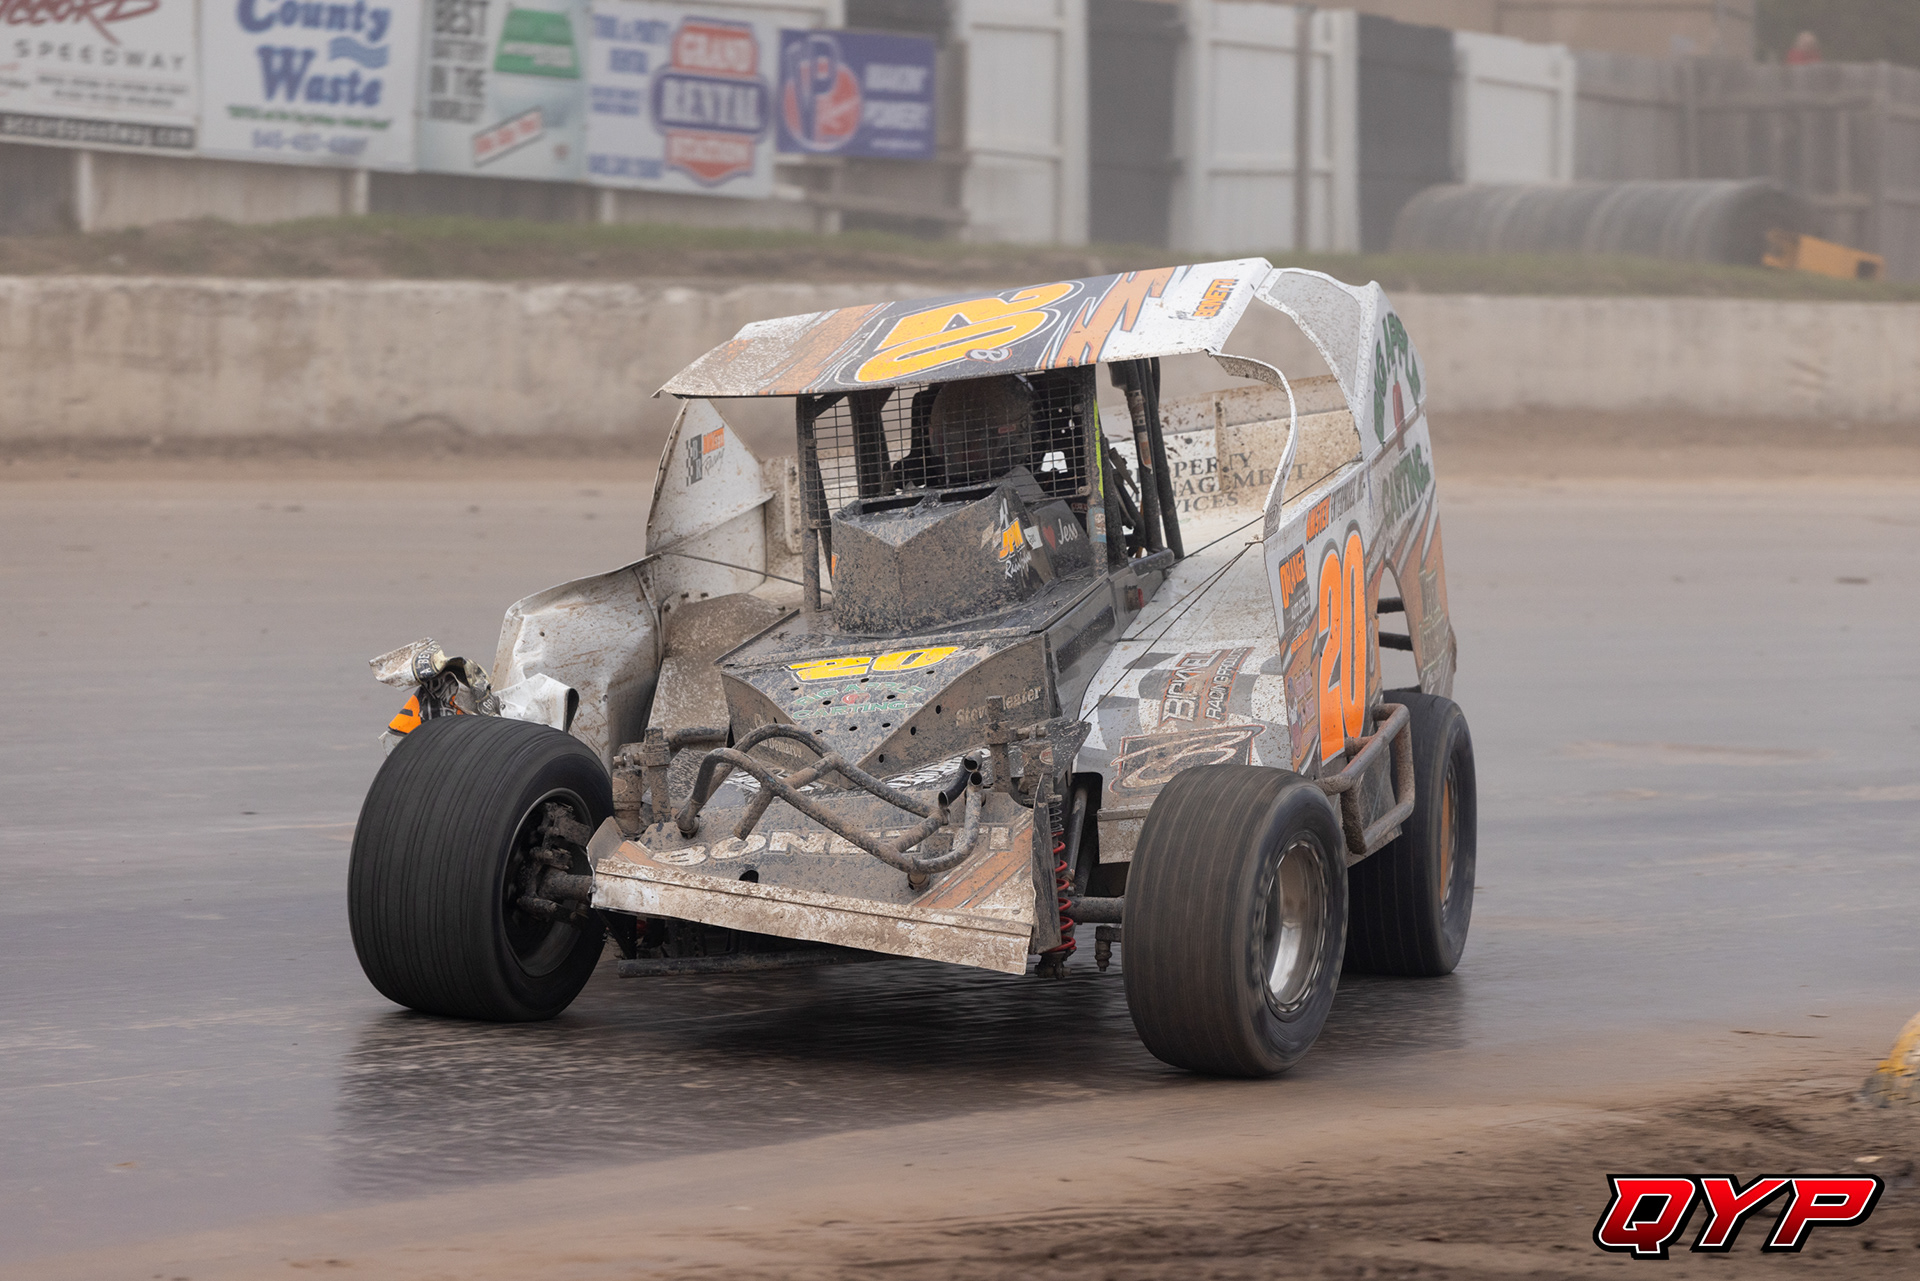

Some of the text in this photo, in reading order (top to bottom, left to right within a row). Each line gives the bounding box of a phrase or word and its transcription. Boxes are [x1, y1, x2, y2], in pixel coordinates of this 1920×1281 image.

[236, 0, 392, 43] County
[14, 38, 186, 72] SPEEDWAY
[680, 34, 754, 73] GRAND
[256, 44, 383, 107] Waste
[661, 78, 760, 131] RENTAL
[1058, 518, 1077, 545] Jess
[1279, 547, 1307, 610] ORANGE
[782, 646, 958, 681] 20
[1318, 532, 1368, 765] 20
[792, 700, 907, 719] CARTING
